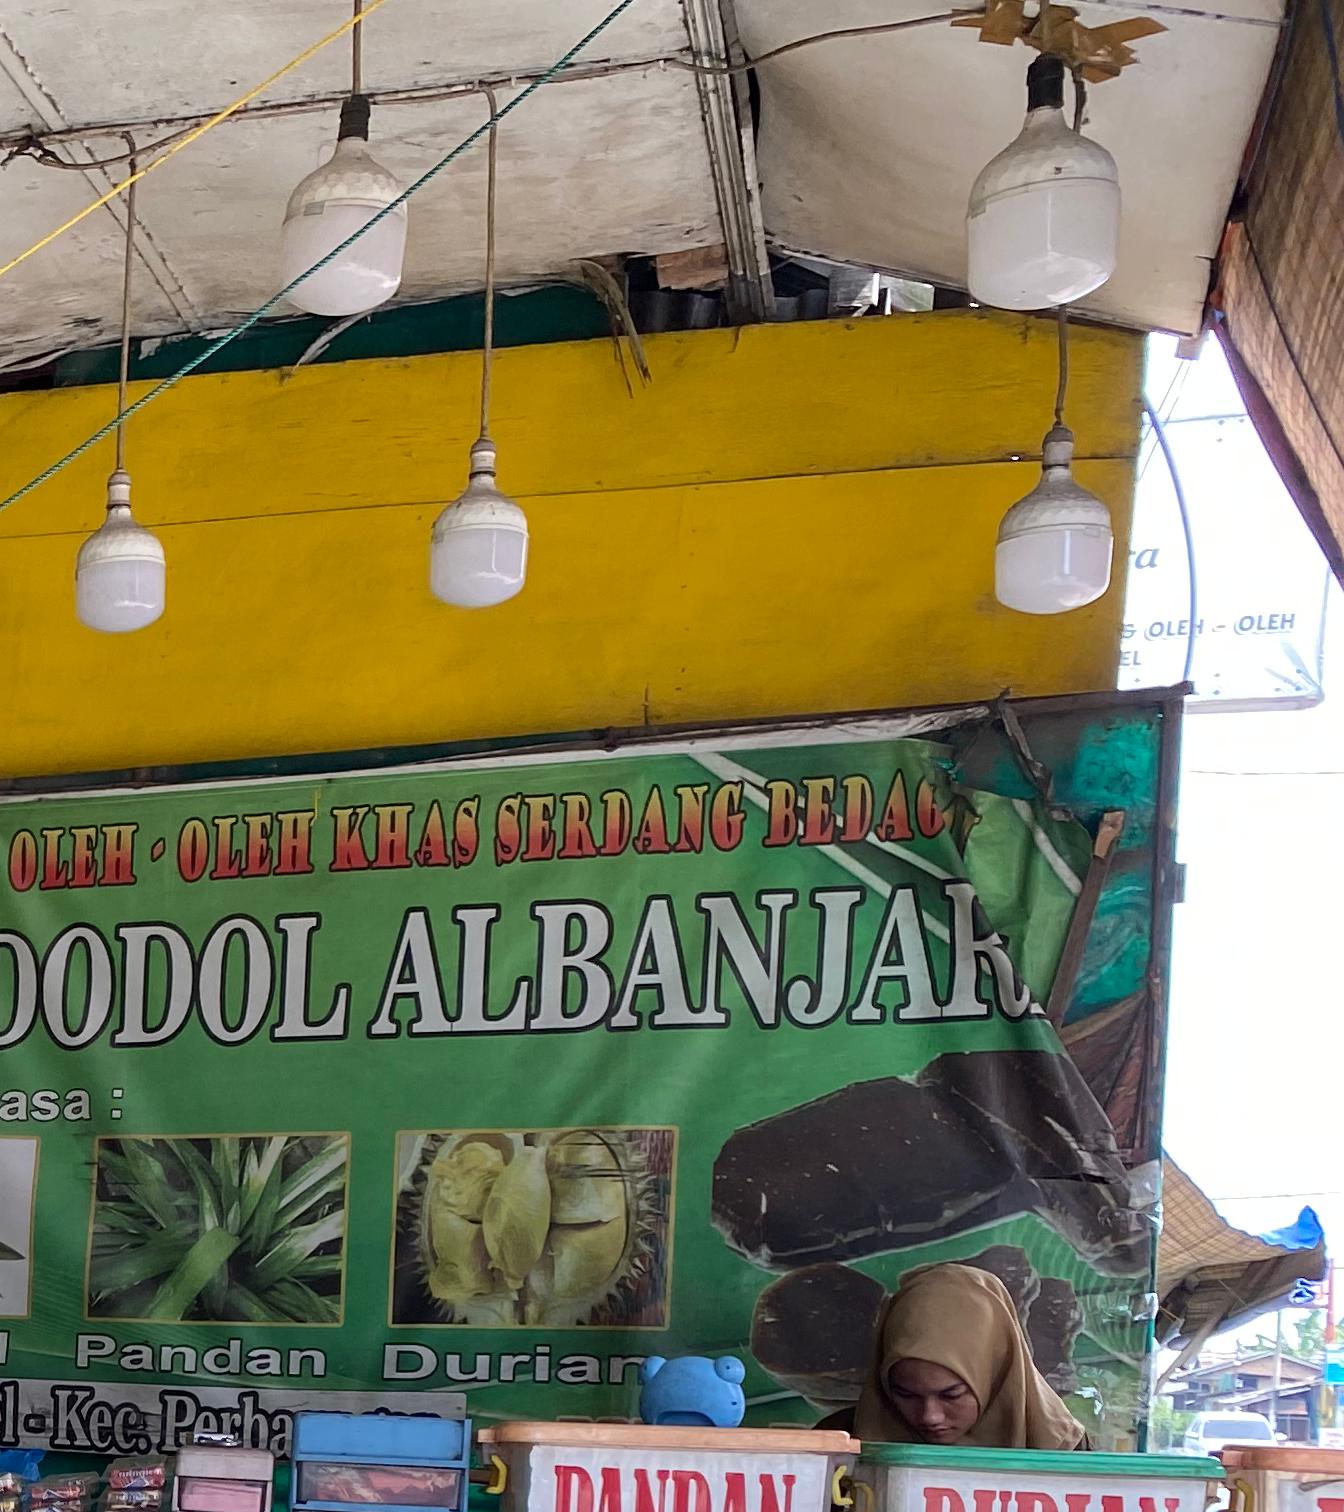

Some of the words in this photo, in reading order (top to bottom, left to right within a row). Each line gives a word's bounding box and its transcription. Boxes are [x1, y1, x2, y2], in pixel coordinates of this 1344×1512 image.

[1146, 618, 1205, 641] OLEH
[1235, 613, 1296, 634] OLEH
[9, 823, 139, 892] OLEH
[177, 808, 316, 883] OLEH
[328, 795, 479, 873] KHAS
[494, 779, 746, 868] SERDANG
[367, 879, 1045, 1040] ALBANJAR
[76, 1333, 328, 1377] Pandan
[381, 1343, 648, 1384] Durian
